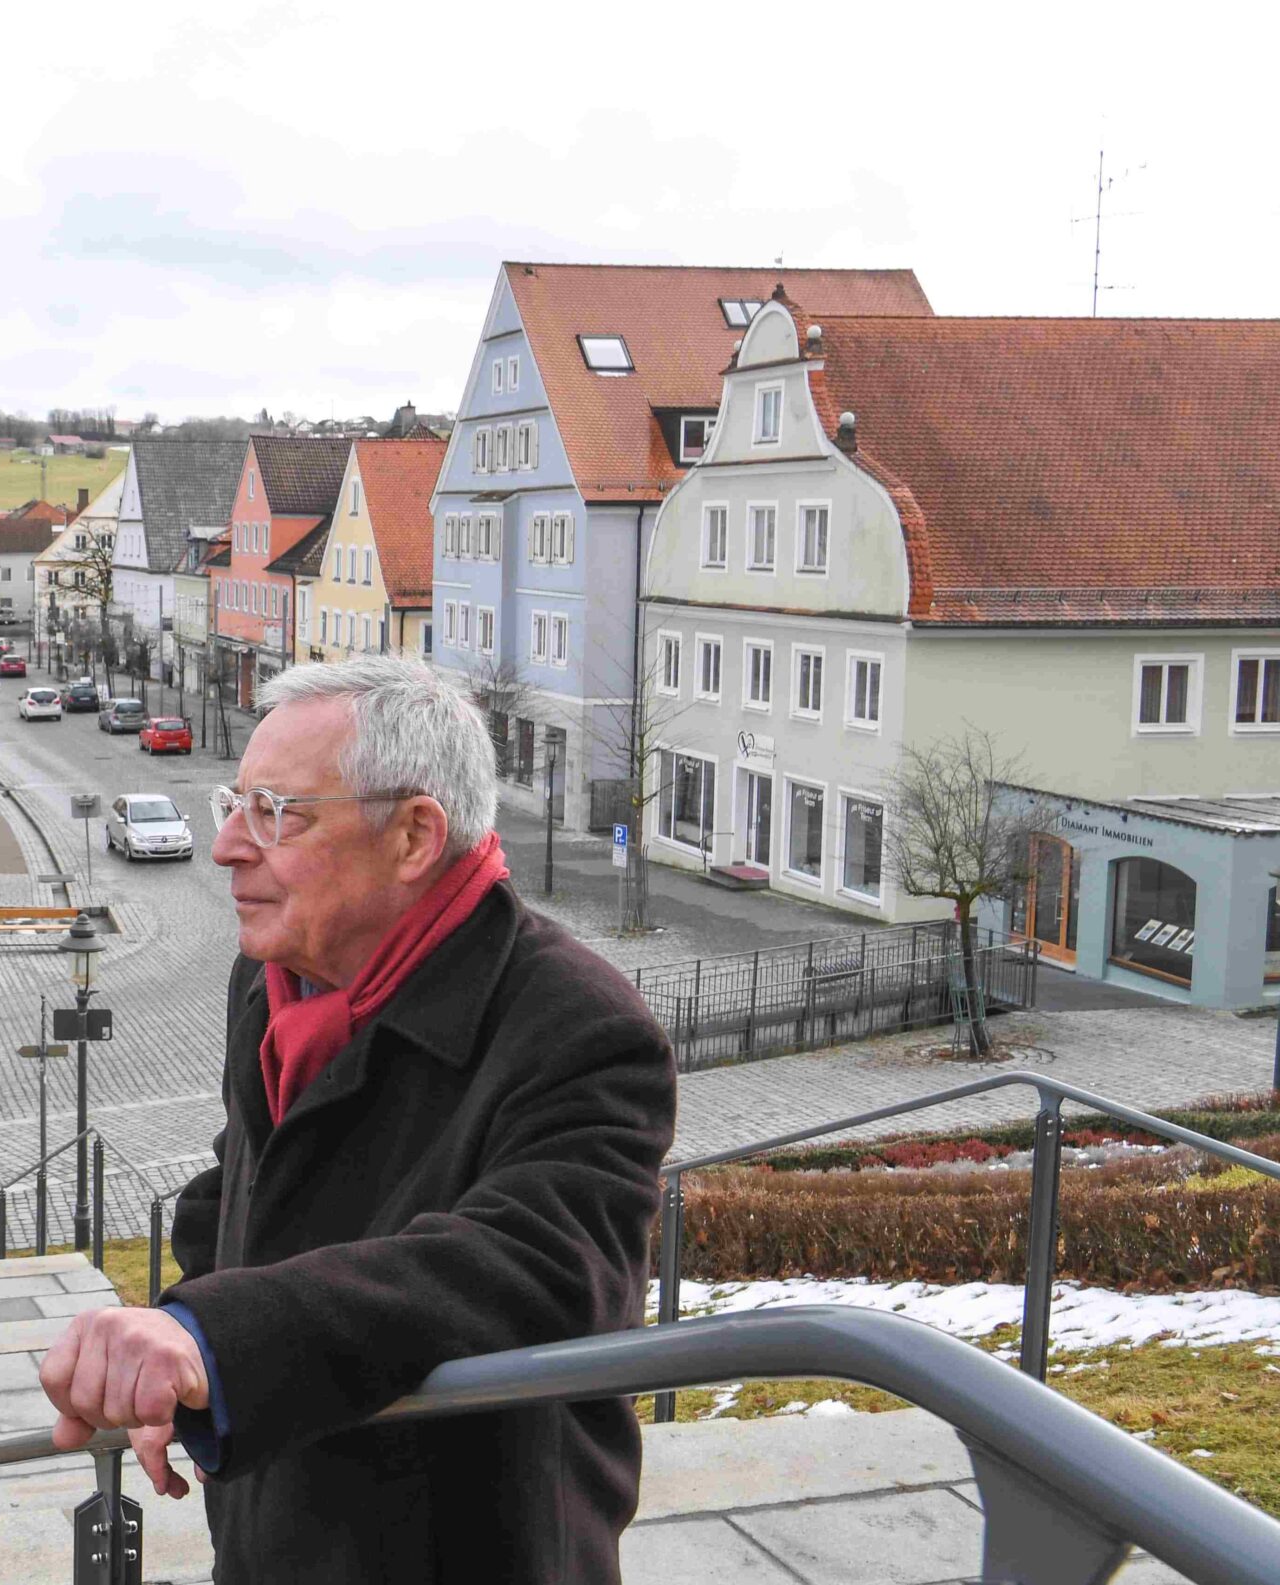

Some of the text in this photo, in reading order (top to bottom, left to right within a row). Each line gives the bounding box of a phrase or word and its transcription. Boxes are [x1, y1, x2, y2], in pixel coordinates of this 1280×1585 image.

[615, 826, 623, 843] P
[1061, 816, 1154, 847] DIAMANT IMMOBILIEN
